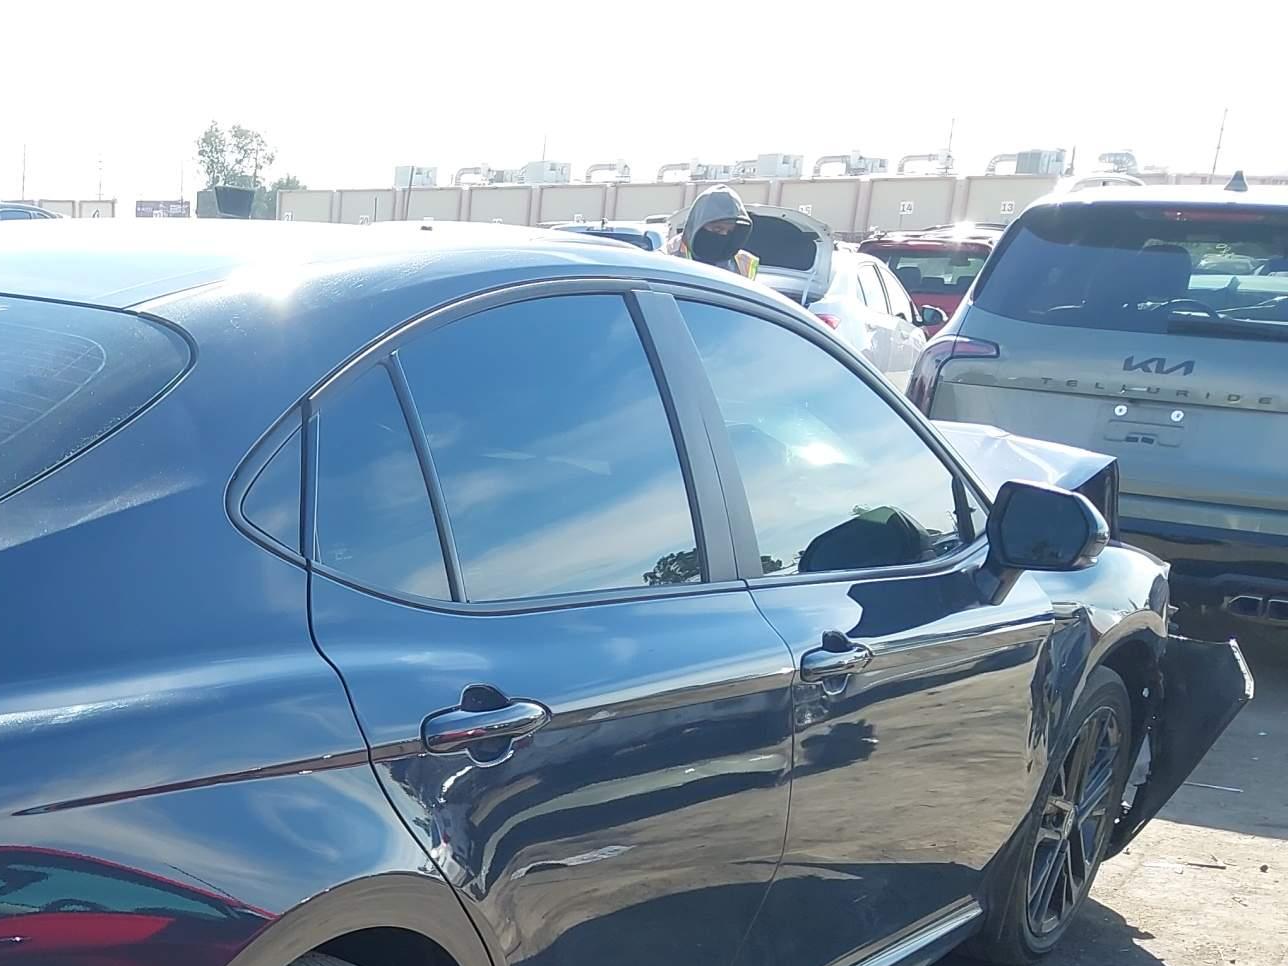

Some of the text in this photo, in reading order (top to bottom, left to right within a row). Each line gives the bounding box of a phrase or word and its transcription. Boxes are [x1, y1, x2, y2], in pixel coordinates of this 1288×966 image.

[901, 203, 913, 213] 14
[1002, 203, 1014, 213] 13
[1122, 355, 1196, 376] KIA
